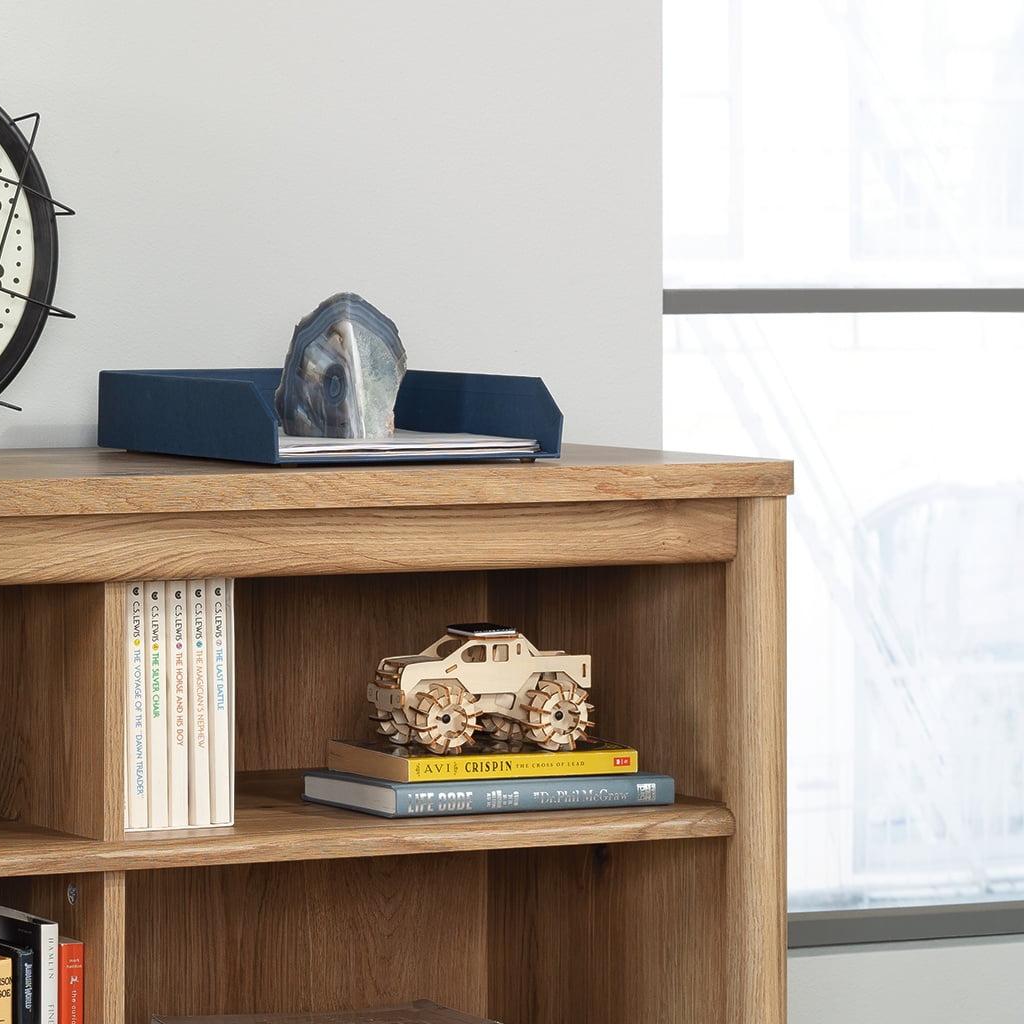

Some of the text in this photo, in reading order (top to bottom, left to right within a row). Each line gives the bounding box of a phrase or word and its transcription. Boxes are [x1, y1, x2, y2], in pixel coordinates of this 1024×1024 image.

[152, 668, 160, 692] SILVER
[135, 701, 142, 711] OF
[152, 694, 160, 718] CHAIR
[424, 764, 450, 773] AVI
[464, 760, 513, 773] CRISPIN
[408, 791, 434, 813] LIFE
